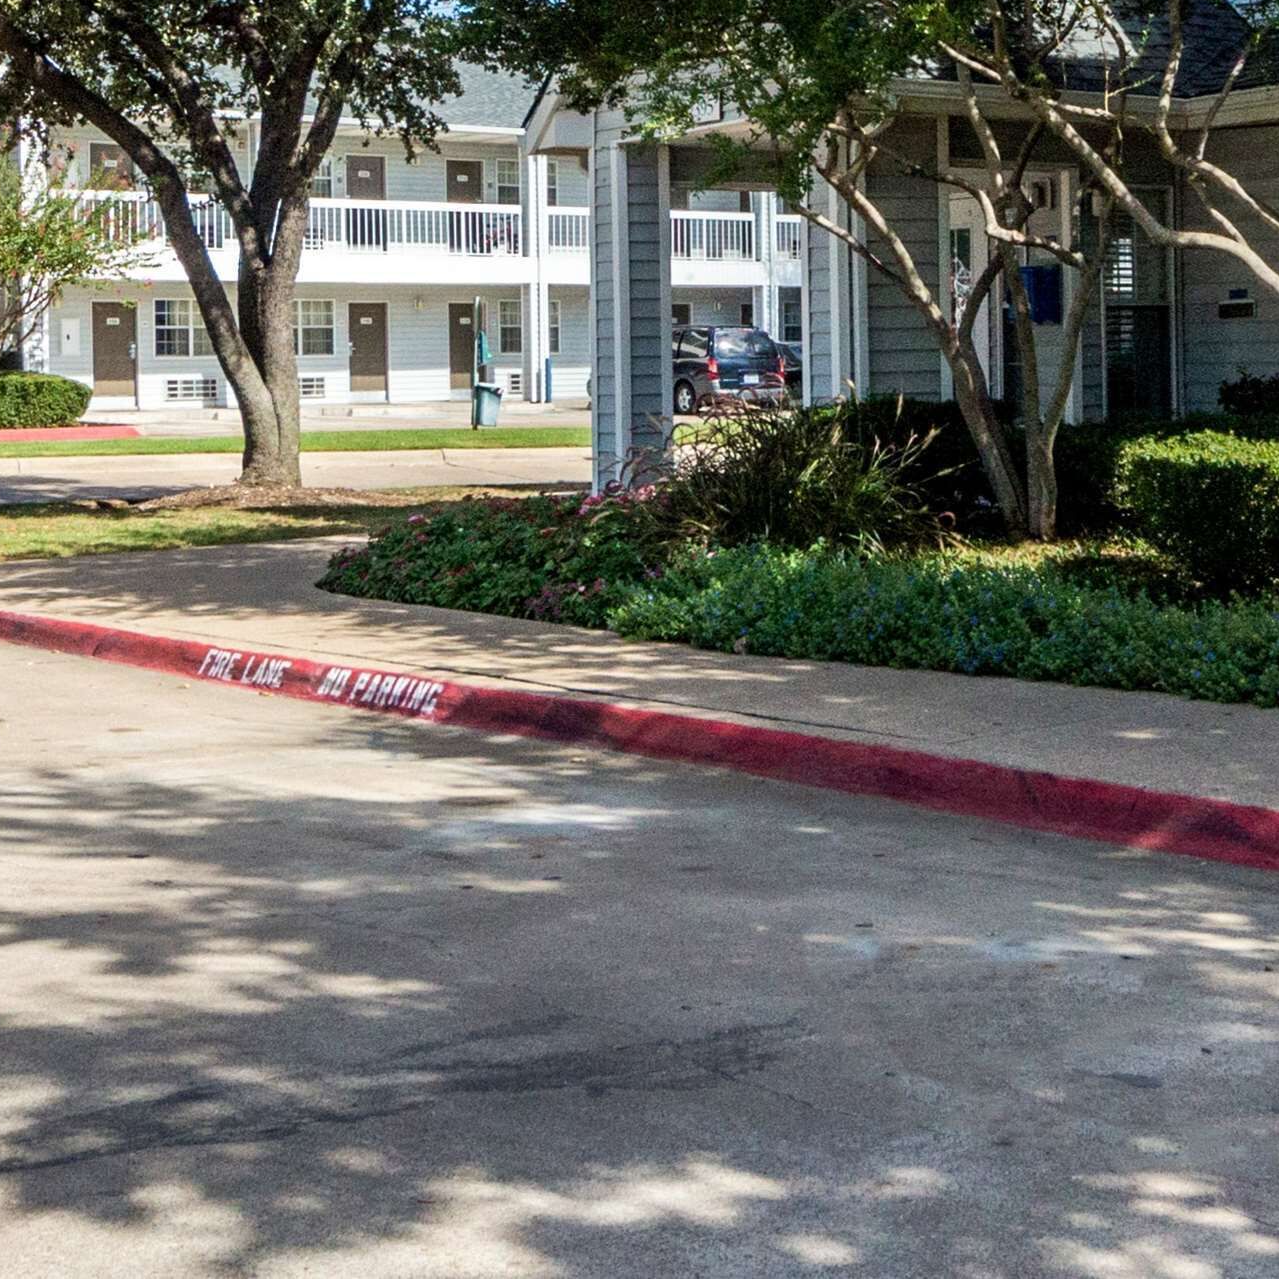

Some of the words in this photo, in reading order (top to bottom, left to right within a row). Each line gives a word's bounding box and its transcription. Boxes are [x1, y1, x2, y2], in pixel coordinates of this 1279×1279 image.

[197, 648, 242, 681] FIRE
[241, 655, 292, 688] LANE
[317, 667, 352, 698] NO
[347, 672, 445, 712] PARKING
